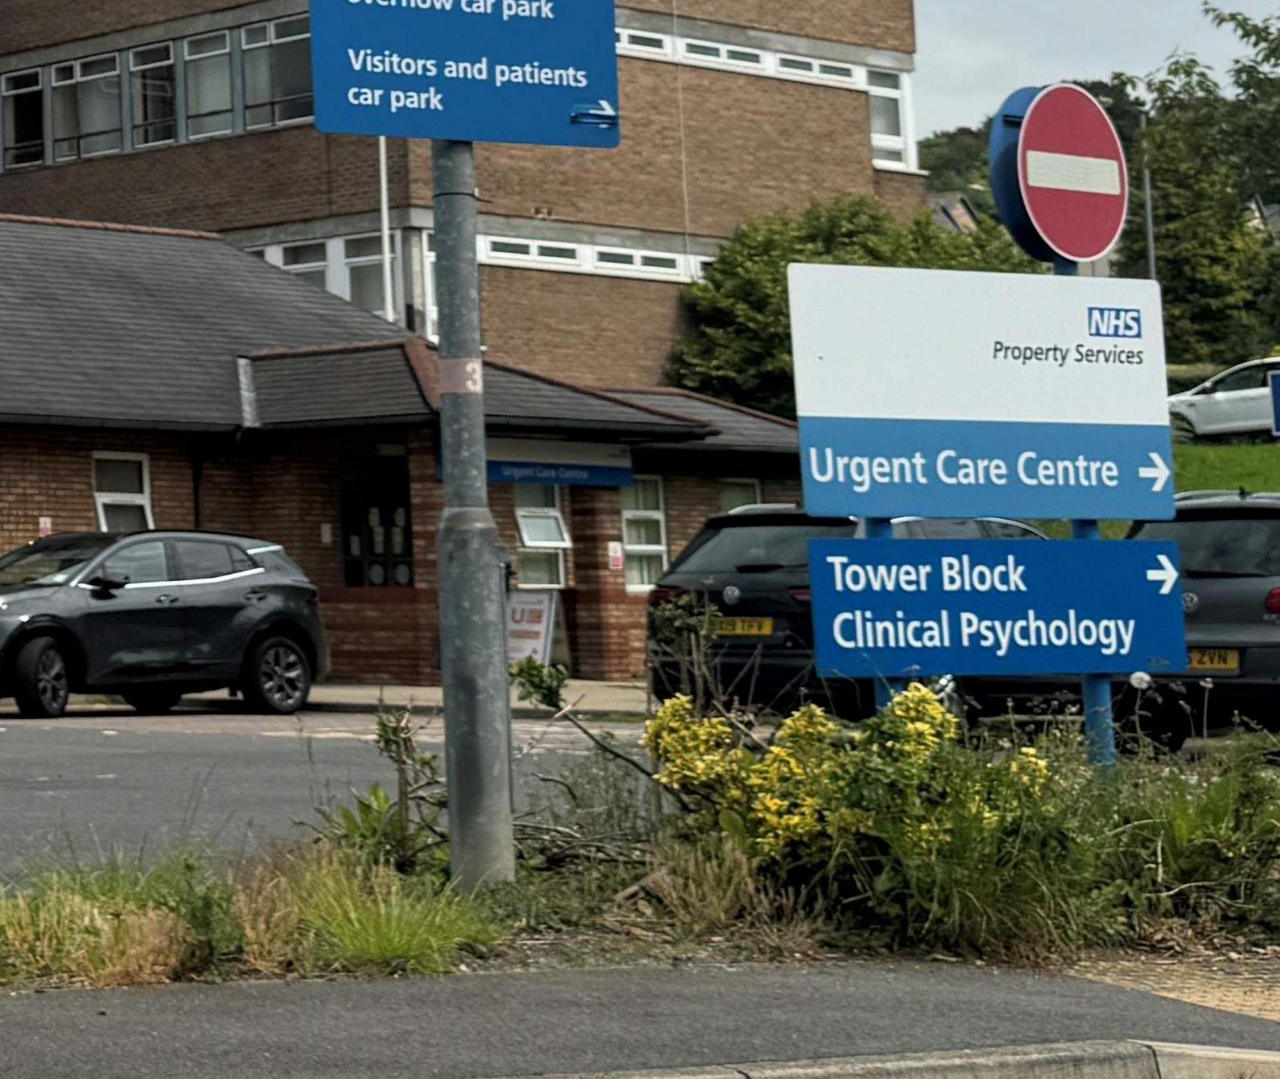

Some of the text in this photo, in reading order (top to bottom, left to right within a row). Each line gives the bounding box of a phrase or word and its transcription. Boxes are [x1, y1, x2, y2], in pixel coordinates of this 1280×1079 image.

[347, 49, 588, 88] Visitors and patients
[347, 86, 444, 113] car park
[1090, 308, 1139, 336] NHS
[992, 340, 1144, 367] Property Services
[465, 362, 482, 392] 3
[809, 447, 1119, 493] Urgent Care Centre
[826, 554, 1027, 592] Tower Block
[833, 609, 1135, 656] Clinical Psychology
